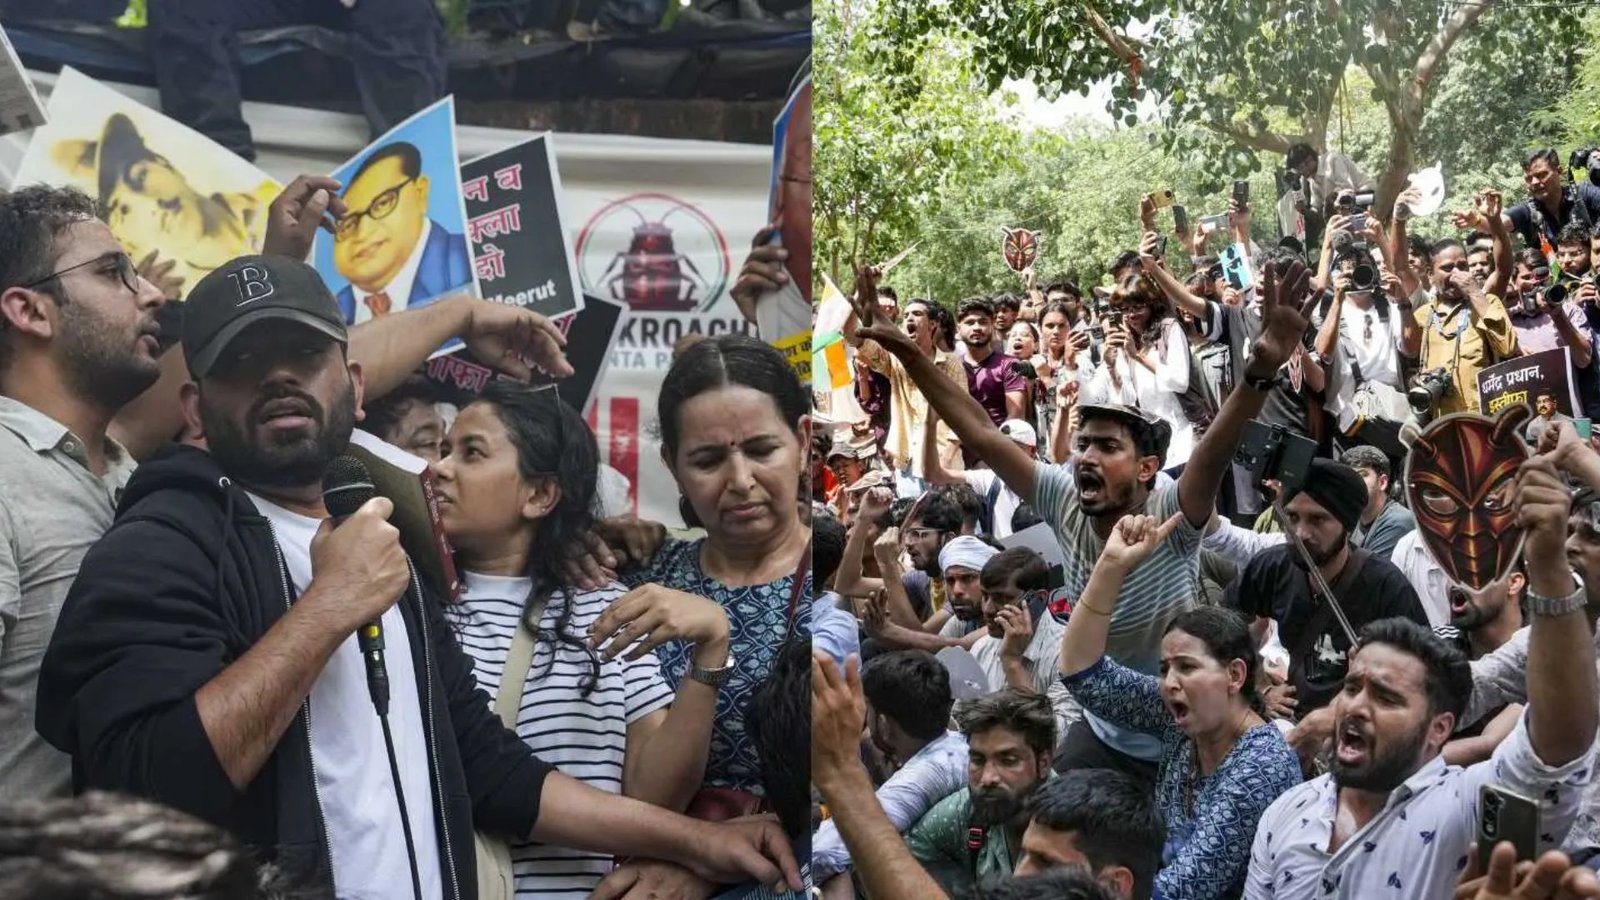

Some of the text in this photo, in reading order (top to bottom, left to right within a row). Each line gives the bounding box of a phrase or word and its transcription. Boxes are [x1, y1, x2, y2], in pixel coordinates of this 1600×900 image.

[463, 175, 489, 202] न
[227, 262, 274, 307] B
[1505, 365, 1545, 387] प्रधान,
